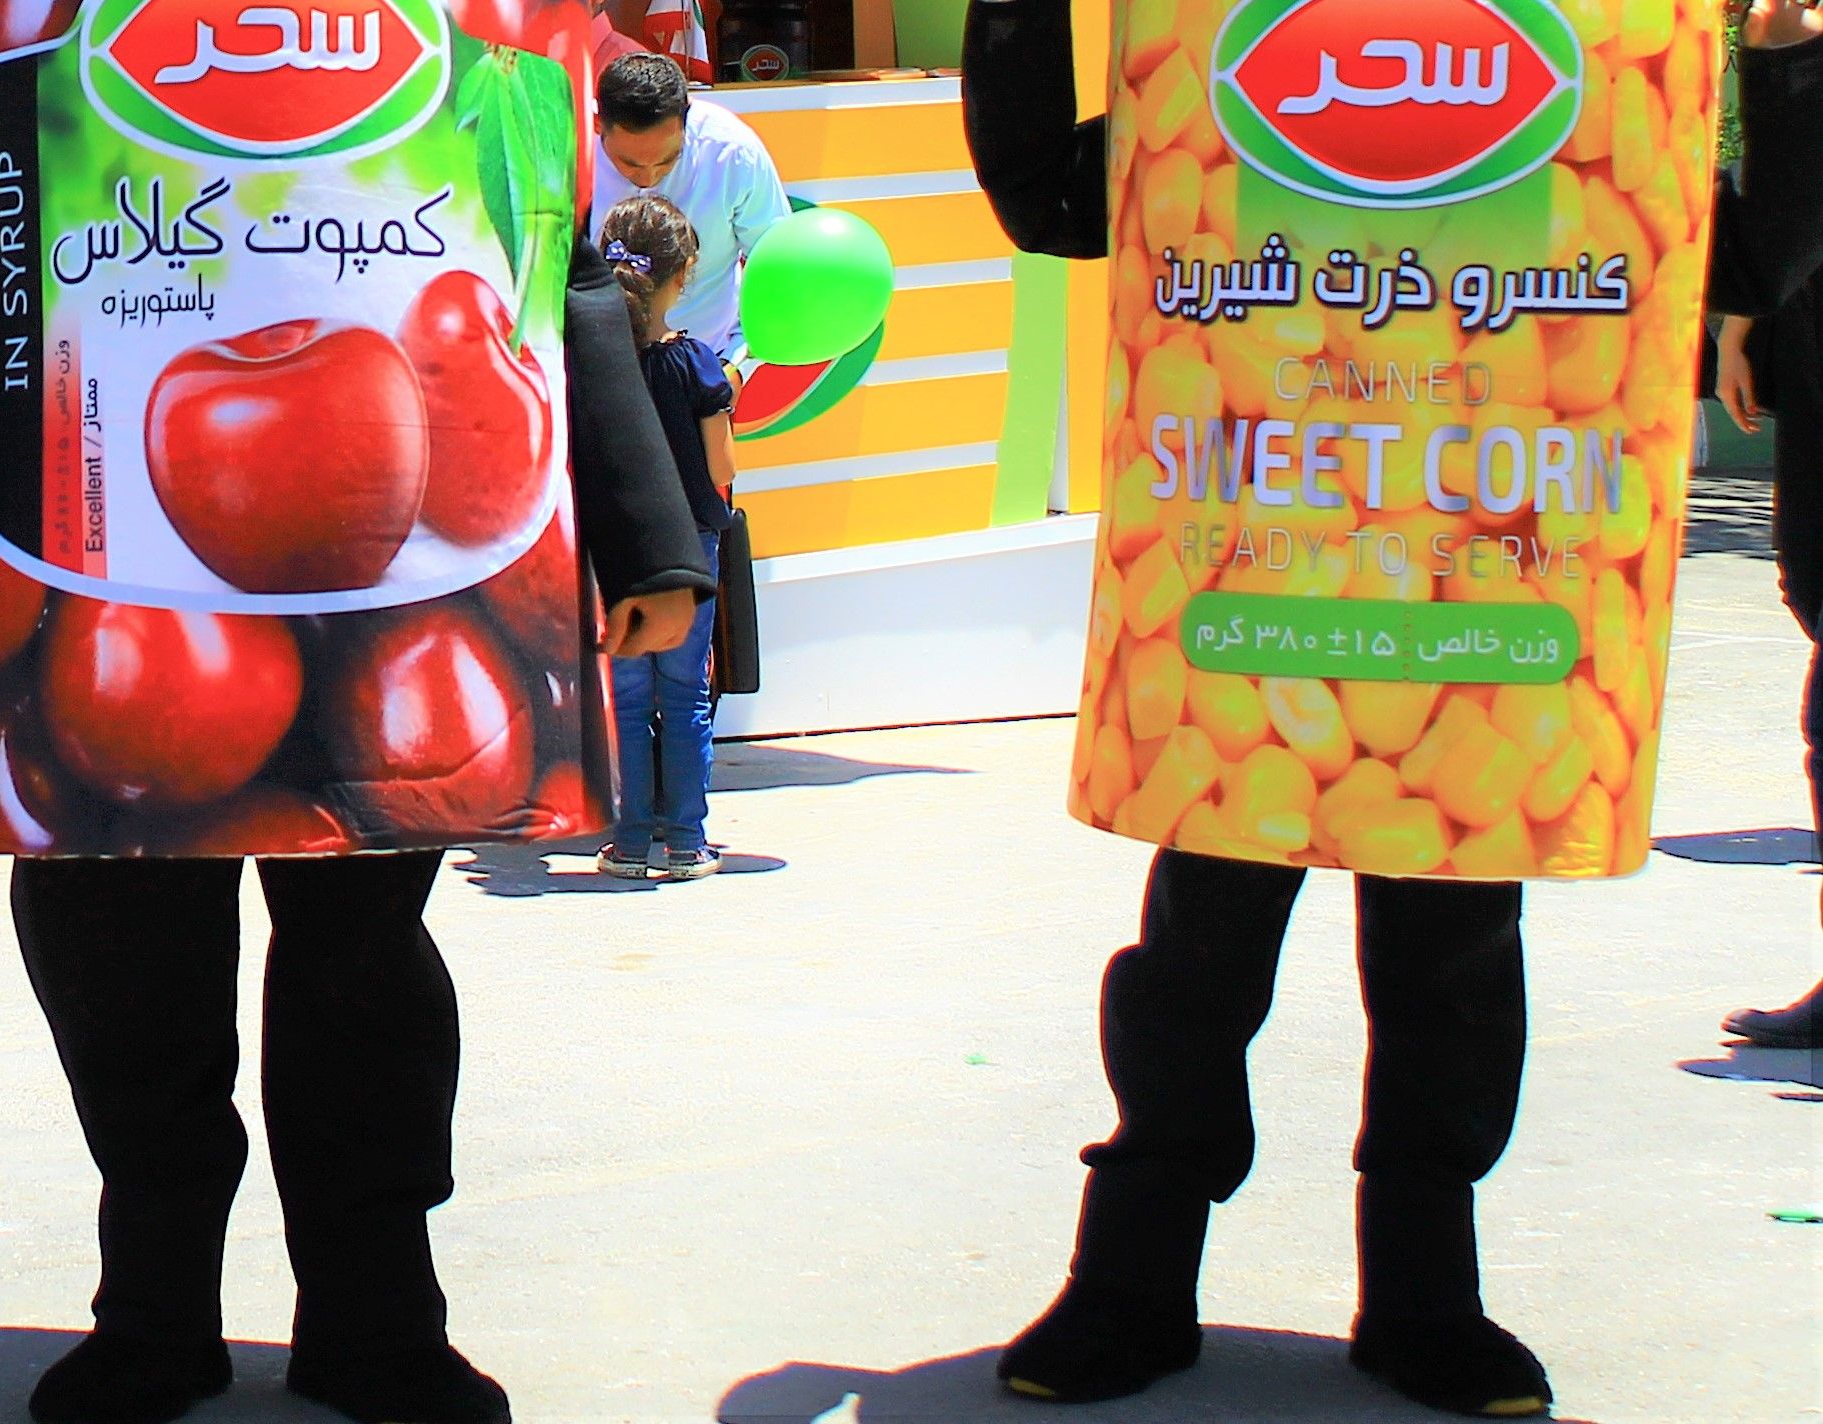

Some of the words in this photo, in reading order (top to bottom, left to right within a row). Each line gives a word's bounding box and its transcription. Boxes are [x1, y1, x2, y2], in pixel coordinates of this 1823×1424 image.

[153, 6, 382, 85] سحر
[1276, 38, 1512, 116] سحر
[53, 176, 231, 285] گیلاس
[245, 186, 453, 285] کمپوت
[101, 273, 215, 329] پاستوریزه
[1154, 232, 1300, 323] شیرین
[1314, 248, 1434, 326] ذرت
[1452, 252, 1630, 331] کنسرو
[4, 336, 29, 391] IN
[1275, 356, 1491, 405] CANNED
[83, 377, 102, 433] ممتاز
[1150, 413, 1402, 509] SWEET
[1423, 424, 1623, 515] CORN
[84, 456, 103, 553] Excellent
[1180, 522, 1326, 571] READY
[1347, 531, 1407, 575] TO
[1431, 533, 1580, 577] SERVE
[1196, 615, 1244, 652] گرم
[1417, 629, 1501, 661] خالص
[1508, 629, 1559, 664] وزن
